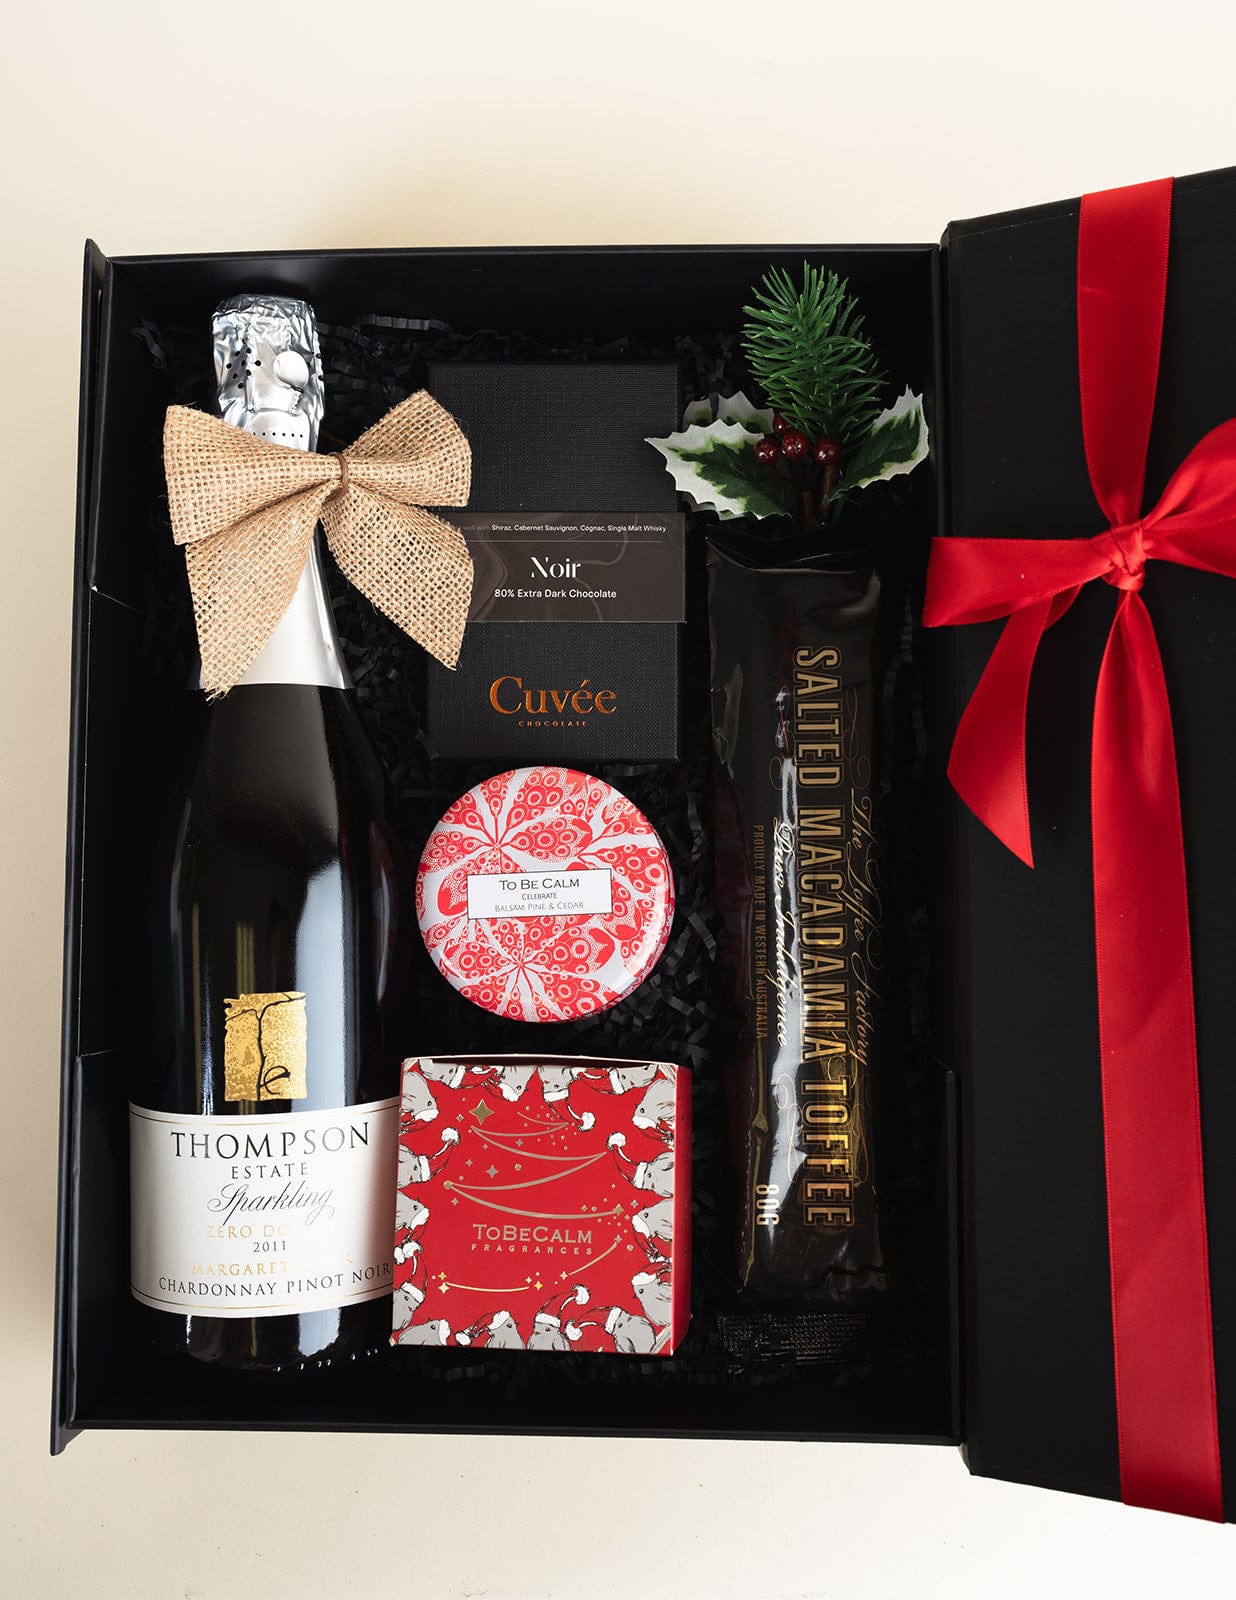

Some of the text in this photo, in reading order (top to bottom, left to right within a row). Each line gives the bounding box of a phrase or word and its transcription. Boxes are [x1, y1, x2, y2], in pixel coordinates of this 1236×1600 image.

[491, 525, 513, 533] Shiraz,
[545, 525, 579, 534] Sauvignon,
[580, 525, 606, 534] Cognac,
[607, 525, 627, 534] Single
[628, 525, 643, 533] Malt
[643, 525, 667, 534] Whisky
[531, 557, 581, 578] Noir
[494, 588, 617, 599] 80% Extra Dark Chocolate
[490, 676, 617, 715] Cuvée
[494, 904, 526, 912] BALSAM
[528, 903, 546, 911] PINE
[556, 901, 584, 910] CEDAR
[521, 893, 558, 901] CELEBRATE
[753, 824, 768, 1039] PROUDLY MADE IN WESTERN AUSTRALIA
[765, 816, 799, 1048] Pure Indulgence
[794, 647, 852, 1225] SALTED MACADAMIA TOFFEE
[838, 788, 880, 1067] The Toffee Factory
[170, 1121, 370, 1159] THOMPSON
[231, 1161, 309, 1180] ESTATE
[207, 1180, 337, 1227] Sparkling
[755, 1183, 780, 1226] 80G
[206, 1223, 254, 1240] ZERO
[253, 1240, 287, 1254] 2011
[471, 1243, 593, 1255] FRAGRANCES
[192, 1260, 289, 1276] MARGARET
[158, 1262, 391, 1297] CHARDONNAY PINOT NOIR
